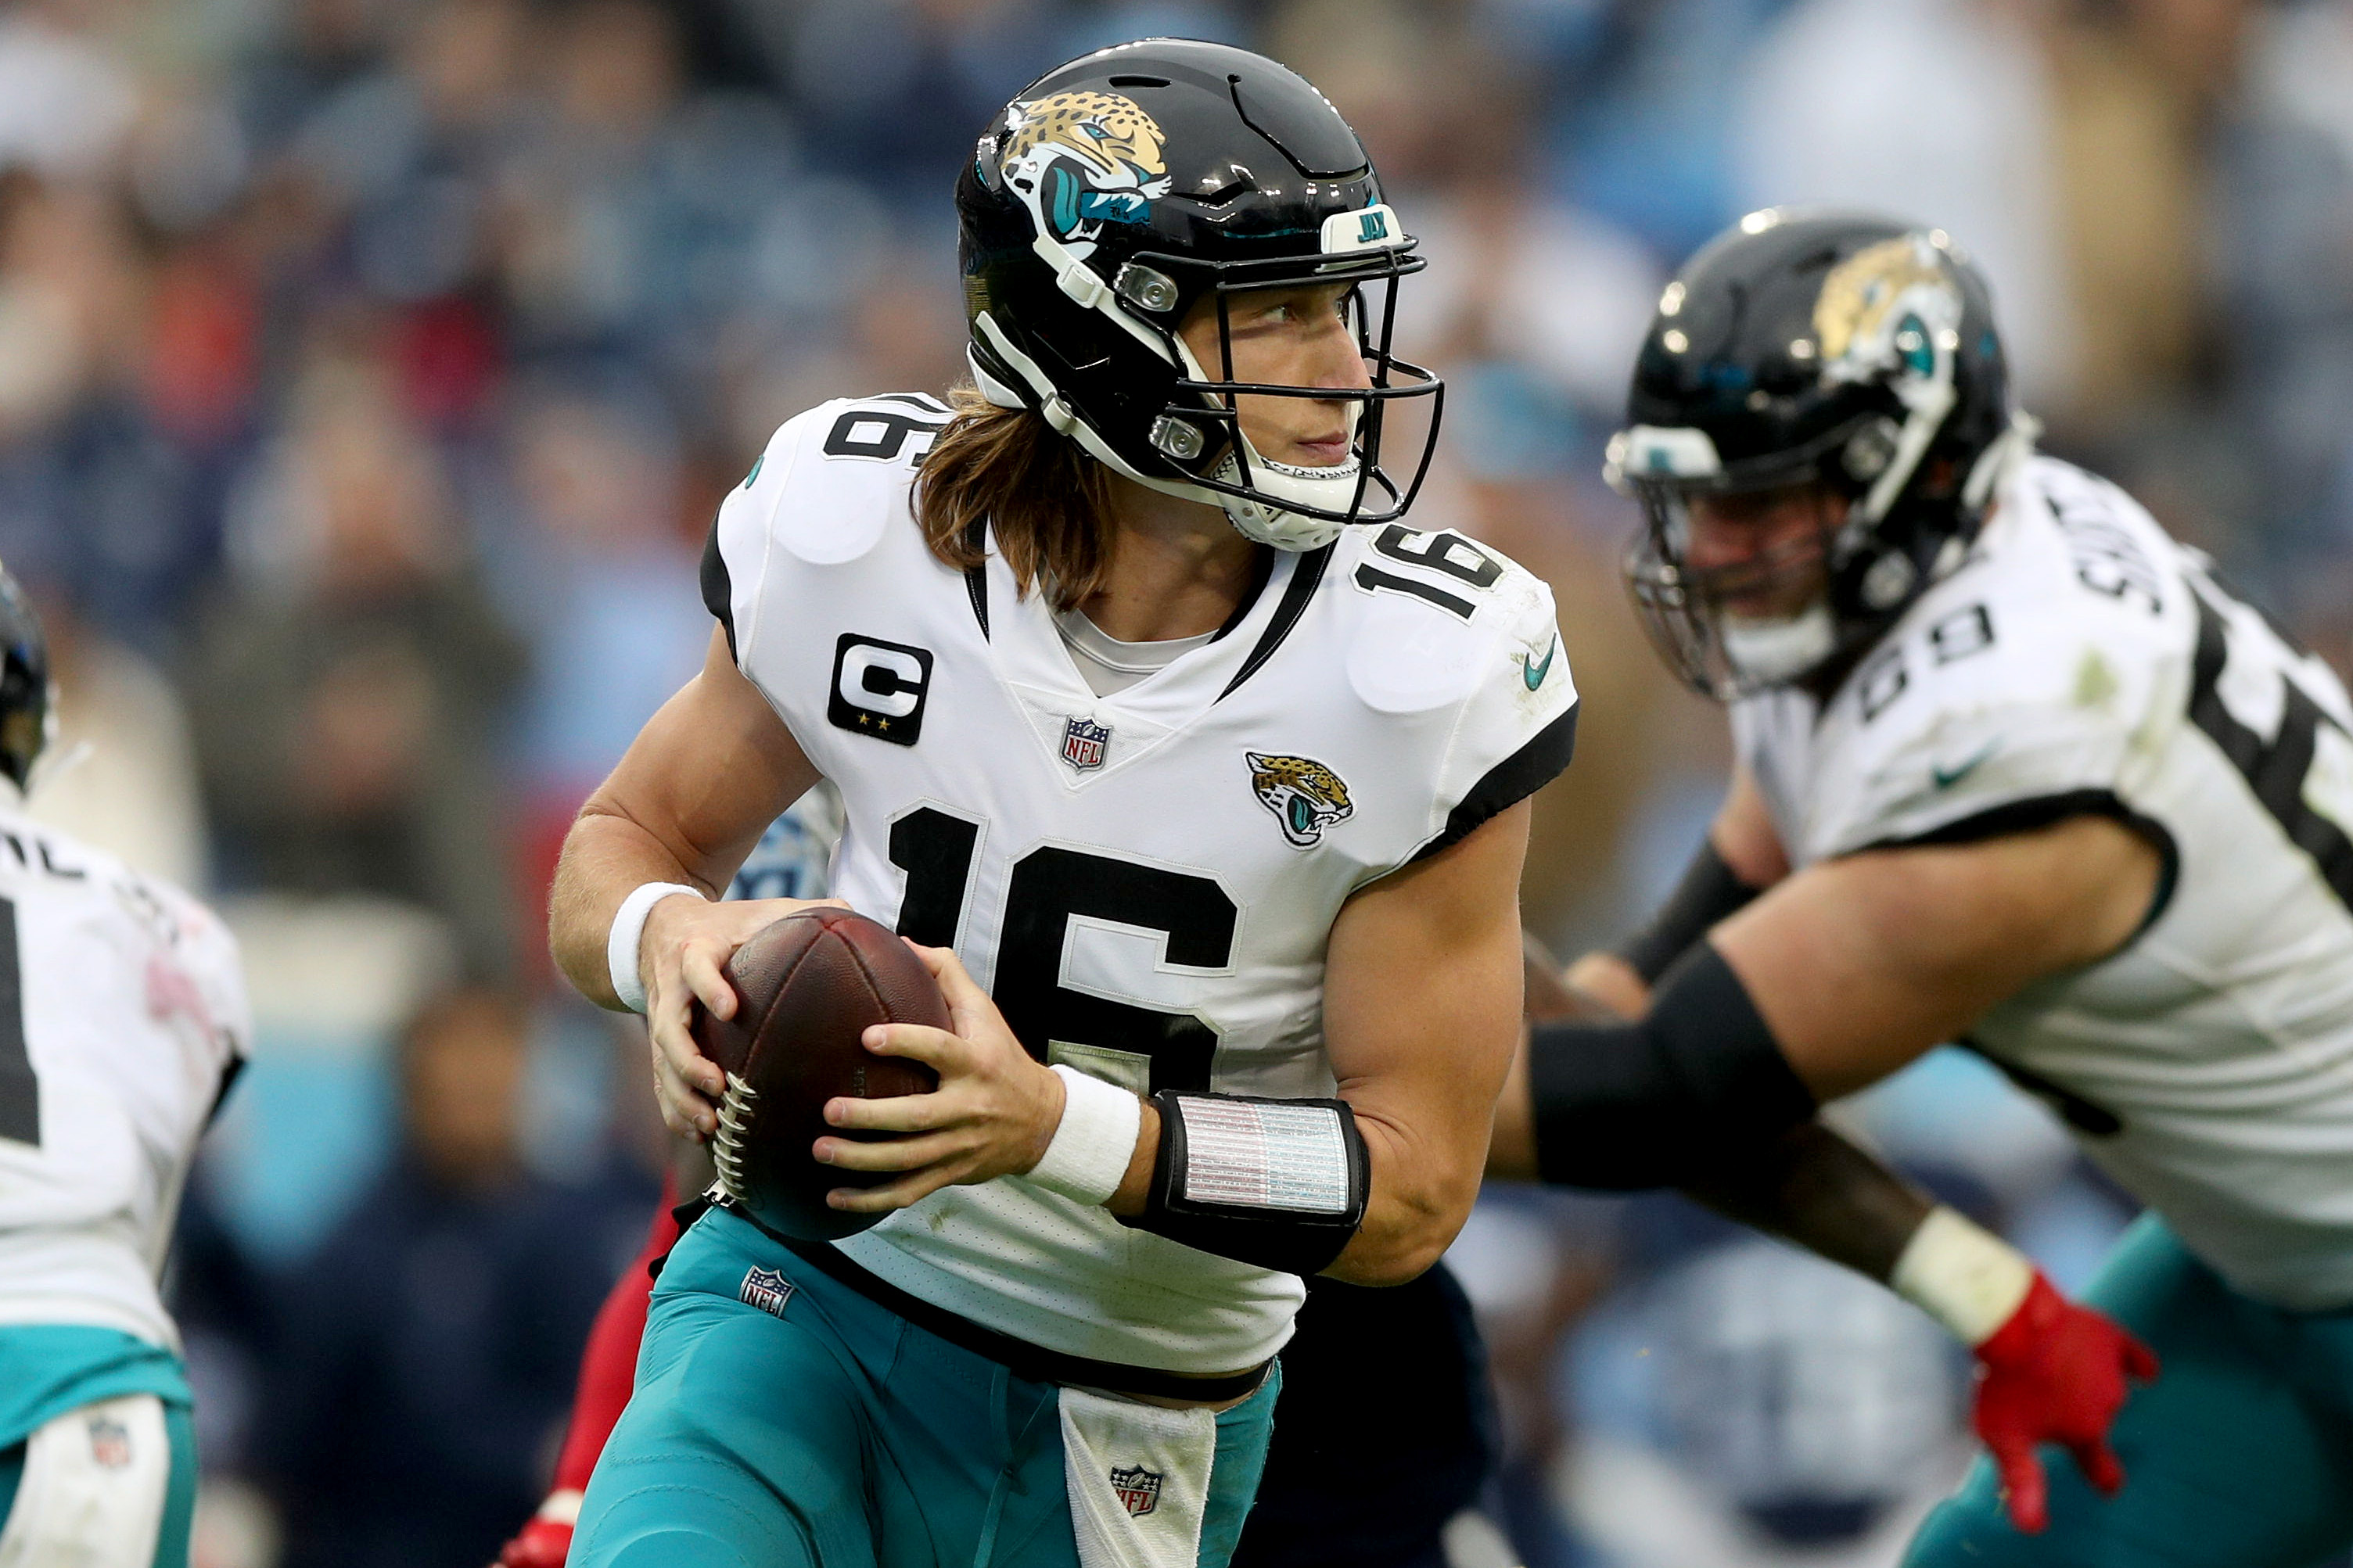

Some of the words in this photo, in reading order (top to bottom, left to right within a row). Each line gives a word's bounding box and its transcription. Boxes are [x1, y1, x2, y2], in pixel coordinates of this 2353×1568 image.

[1355, 524, 1503, 619] 16
[839, 644, 922, 718] C
[1065, 736, 1100, 764] NFL
[888, 806, 1238, 1093] 16
[744, 1285, 778, 1313] NFL
